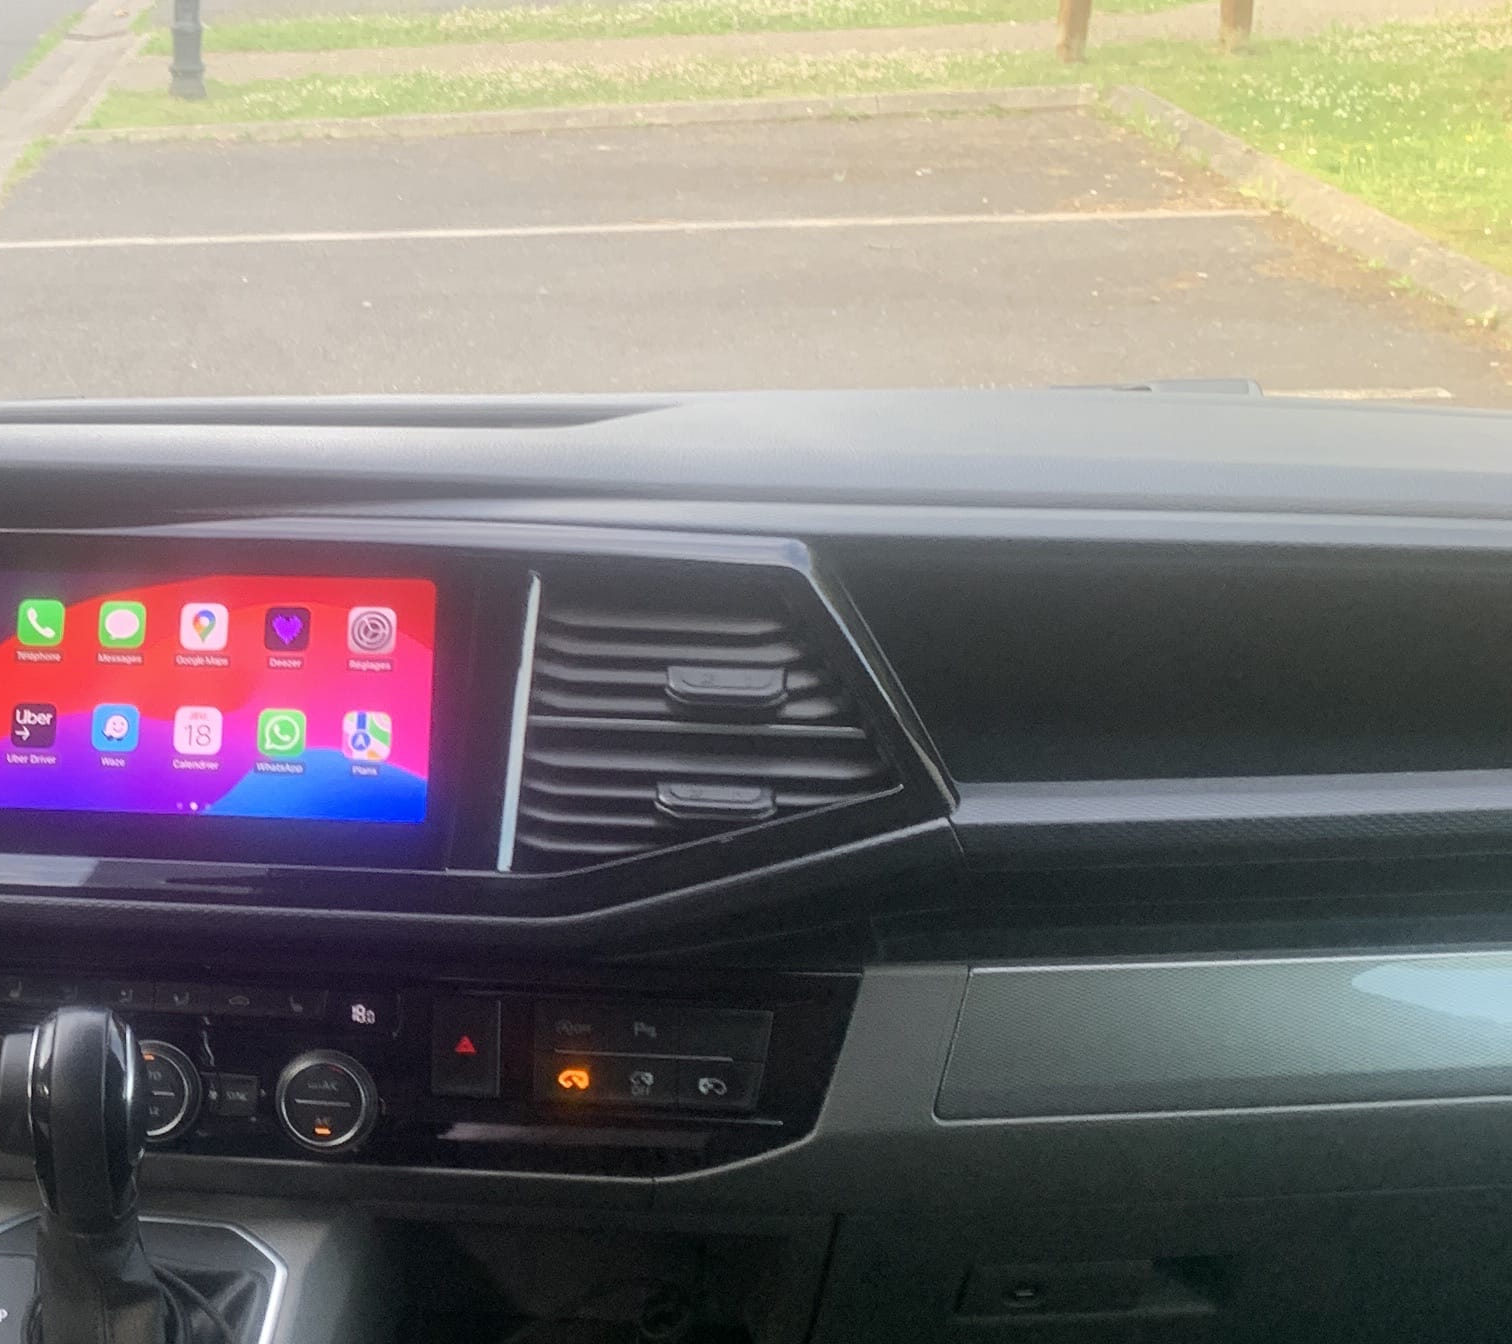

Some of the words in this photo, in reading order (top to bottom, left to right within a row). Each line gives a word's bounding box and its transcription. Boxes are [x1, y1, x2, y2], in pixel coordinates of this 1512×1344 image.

[97, 653, 143, 665] Messages
[15, 709, 53, 726] Uber
[185, 724, 212, 747] 18
[6, 753, 29, 764] Uber
[30, 754, 57, 765] Driver
[100, 756, 126, 767] Waze
[256, 762, 304, 774] WhatsApp
